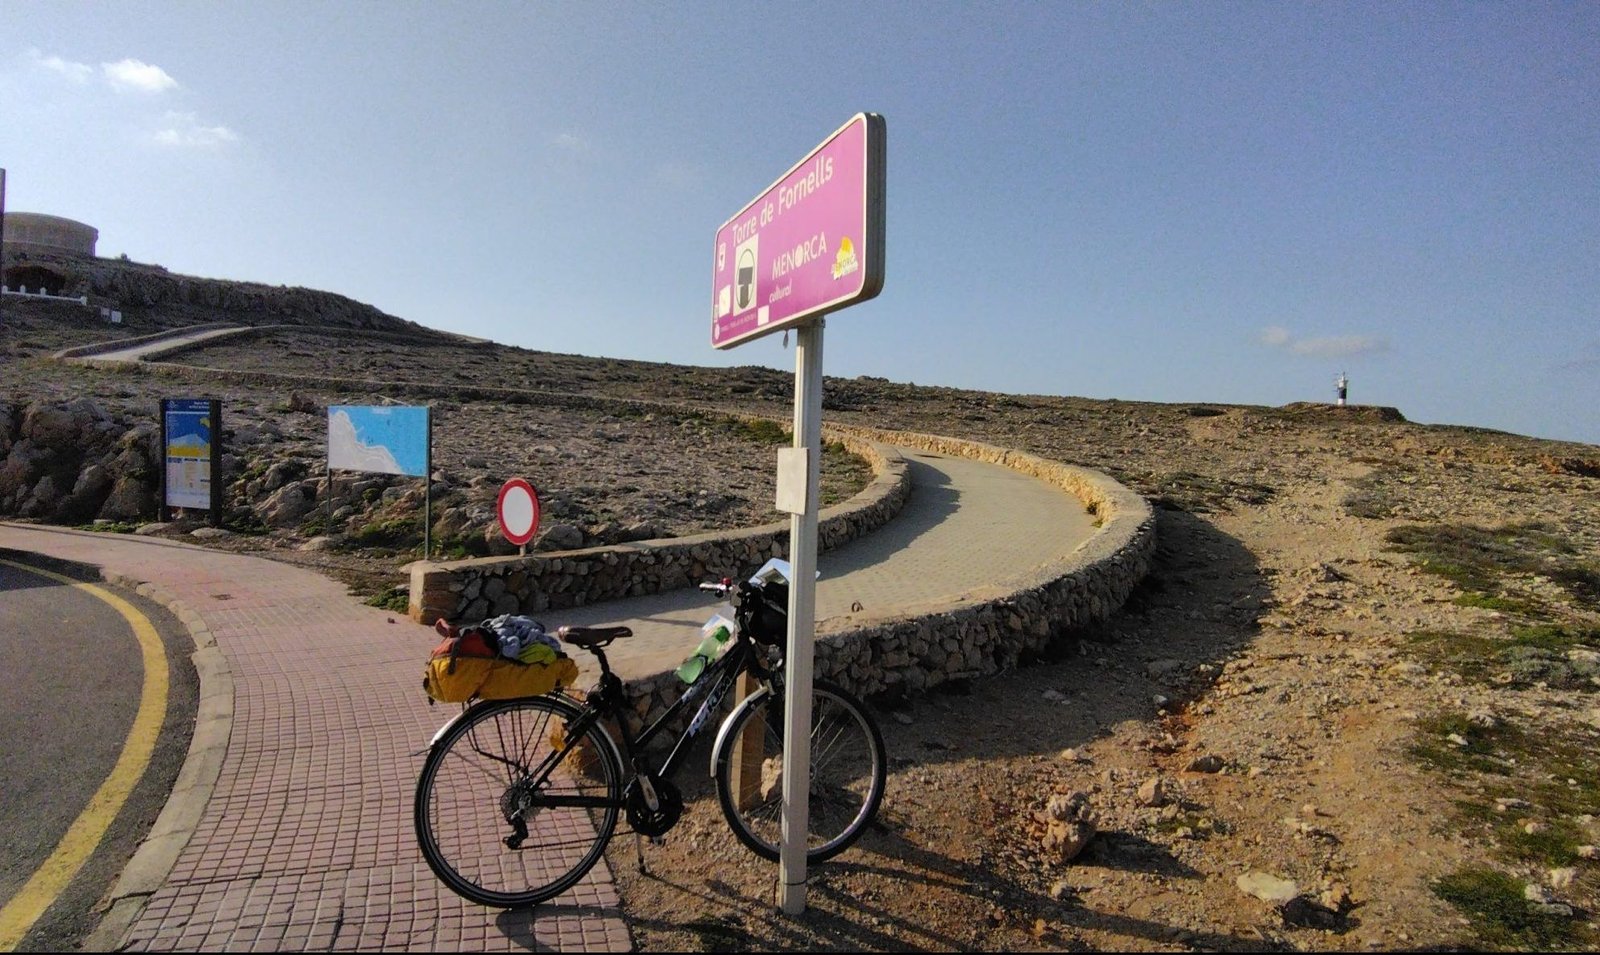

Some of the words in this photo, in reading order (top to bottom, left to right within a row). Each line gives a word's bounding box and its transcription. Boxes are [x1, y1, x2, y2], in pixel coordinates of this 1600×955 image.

[732, 216, 757, 247] Torre
[760, 201, 774, 228] de
[778, 156, 834, 215] Fornells
[772, 231, 827, 280] MENORCA
[769, 278, 792, 304] cultural
